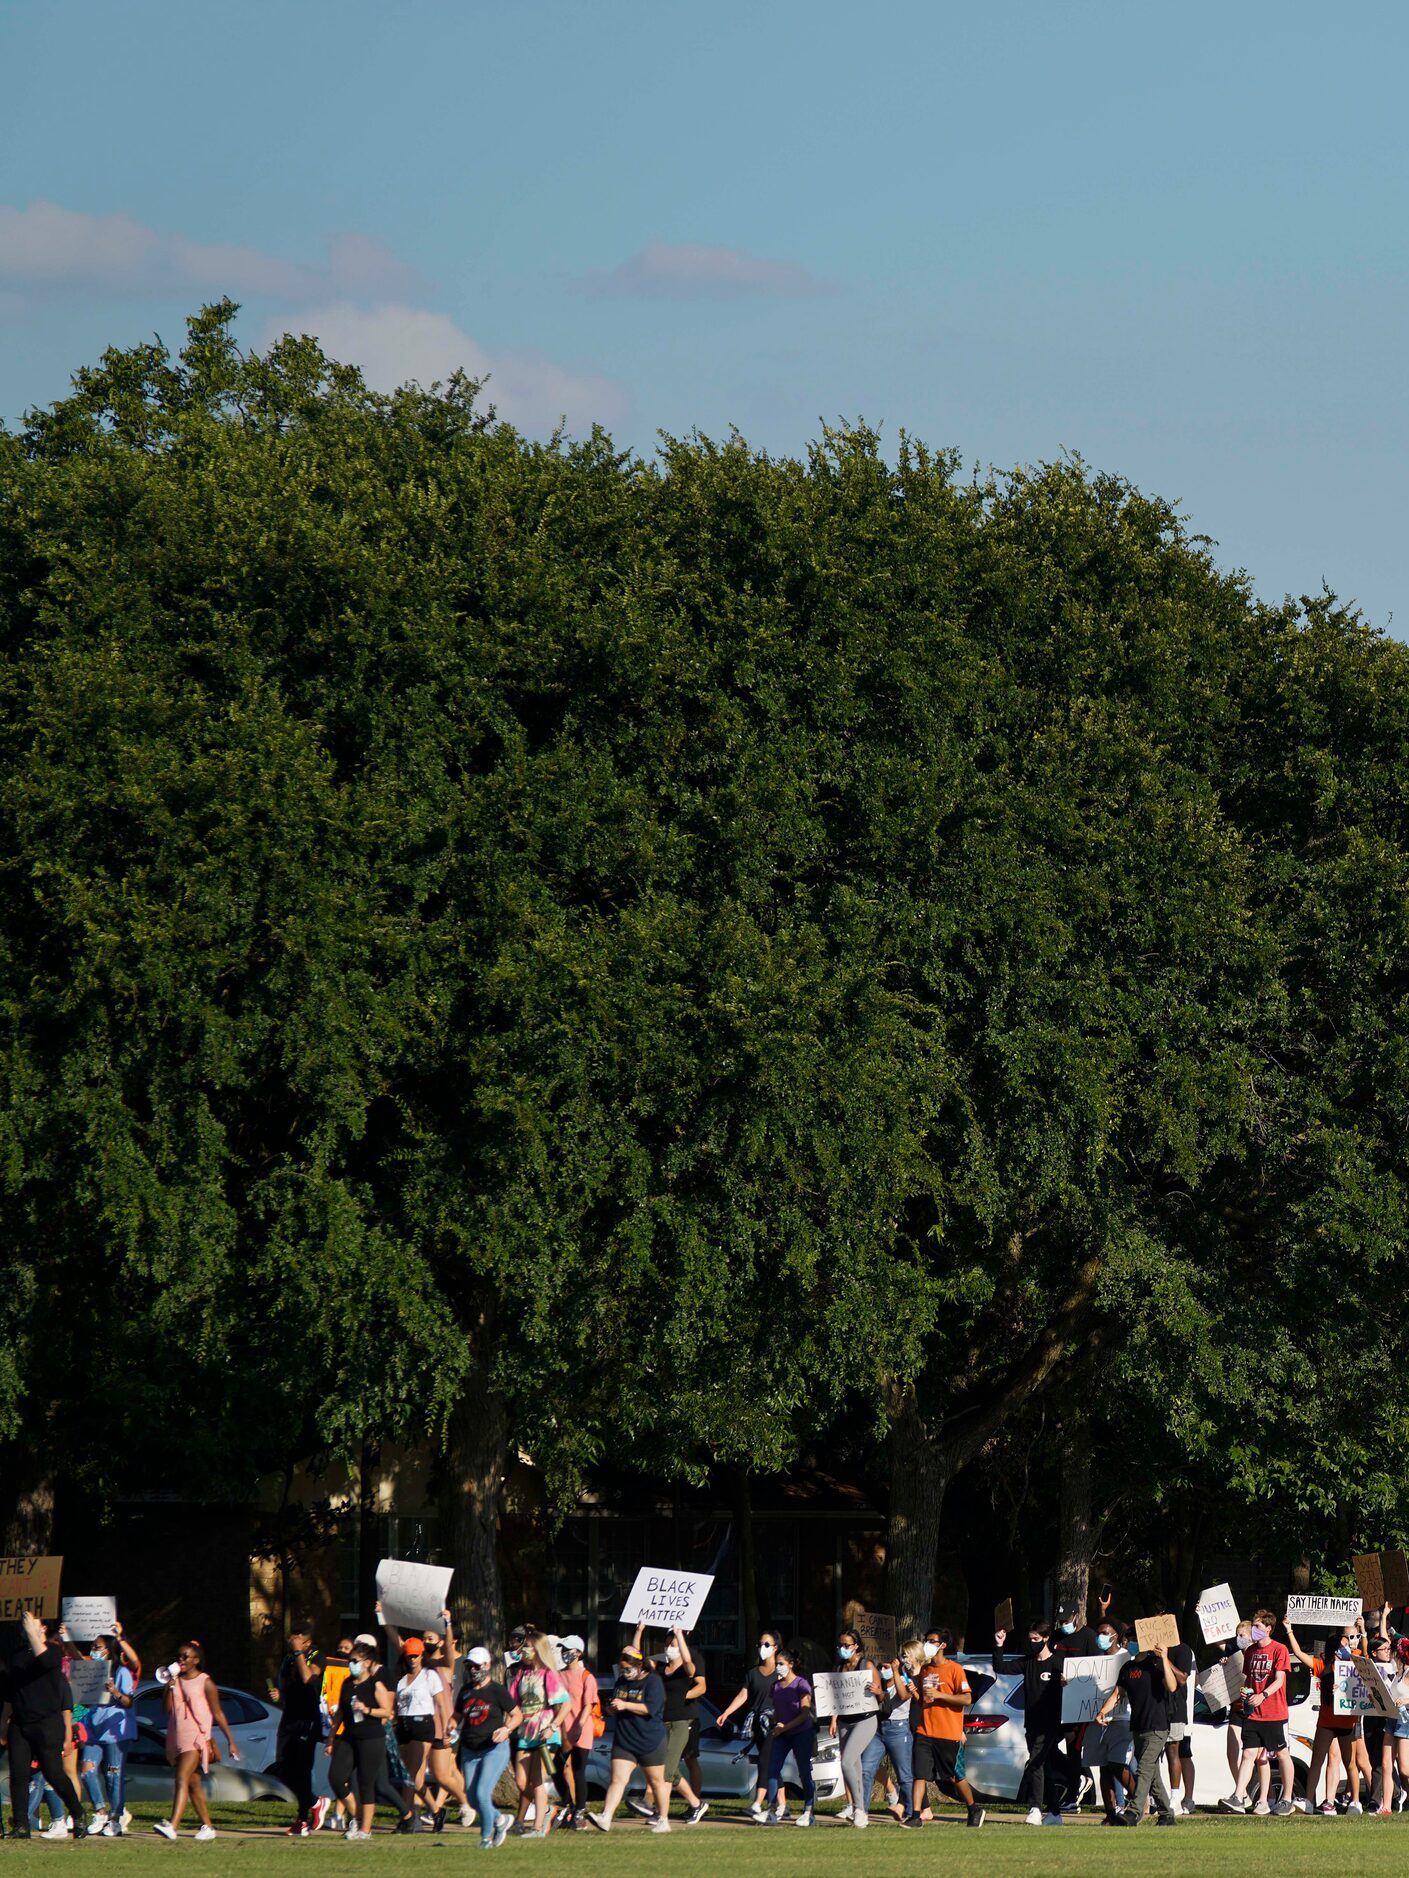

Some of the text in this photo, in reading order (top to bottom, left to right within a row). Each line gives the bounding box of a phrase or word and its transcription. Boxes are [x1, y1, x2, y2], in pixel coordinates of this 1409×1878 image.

[0, 1558, 38, 1575] THEY
[647, 1577, 696, 1594] BLACK
[651, 1595, 690, 1607] LIVES
[1201, 1600, 1232, 1614] JUSTICE
[1289, 1596, 1359, 1612] SAY THEIR NAMES
[637, 1608, 685, 1621] MATTER
[1203, 1615, 1218, 1627] NO
[1138, 1618, 1172, 1633] FUCK
[1204, 1623, 1233, 1639] PEACE
[826, 1677, 861, 1691] MELANIN
[1340, 1699, 1356, 1709] RIP
